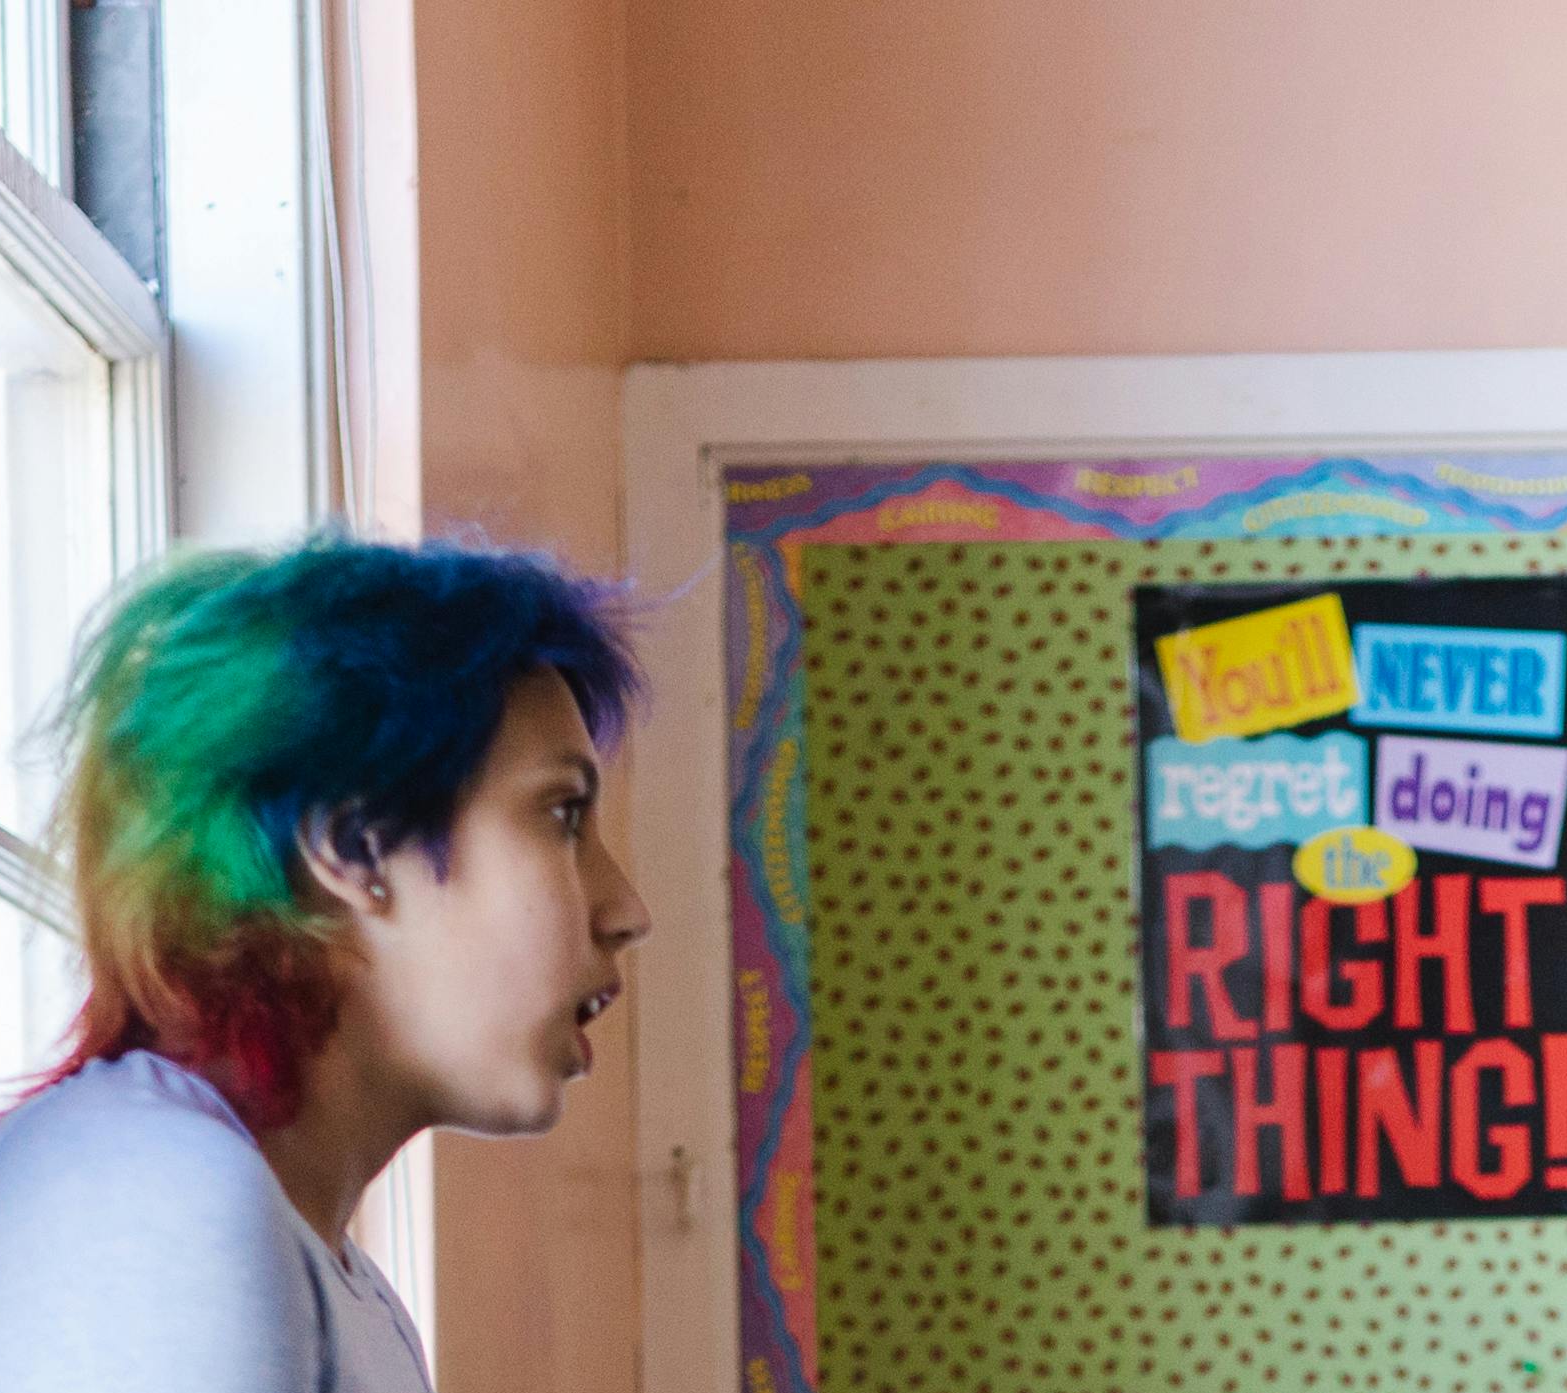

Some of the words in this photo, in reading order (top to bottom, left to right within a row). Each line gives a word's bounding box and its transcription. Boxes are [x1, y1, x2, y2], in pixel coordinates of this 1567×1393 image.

[1175, 611, 1345, 726] You'll
[1367, 642, 1551, 719] NEVER
[1157, 742, 1360, 830] regret
[1389, 755, 1552, 850] doing
[1322, 842, 1390, 889] the
[1163, 870, 1567, 1041] RIGHT
